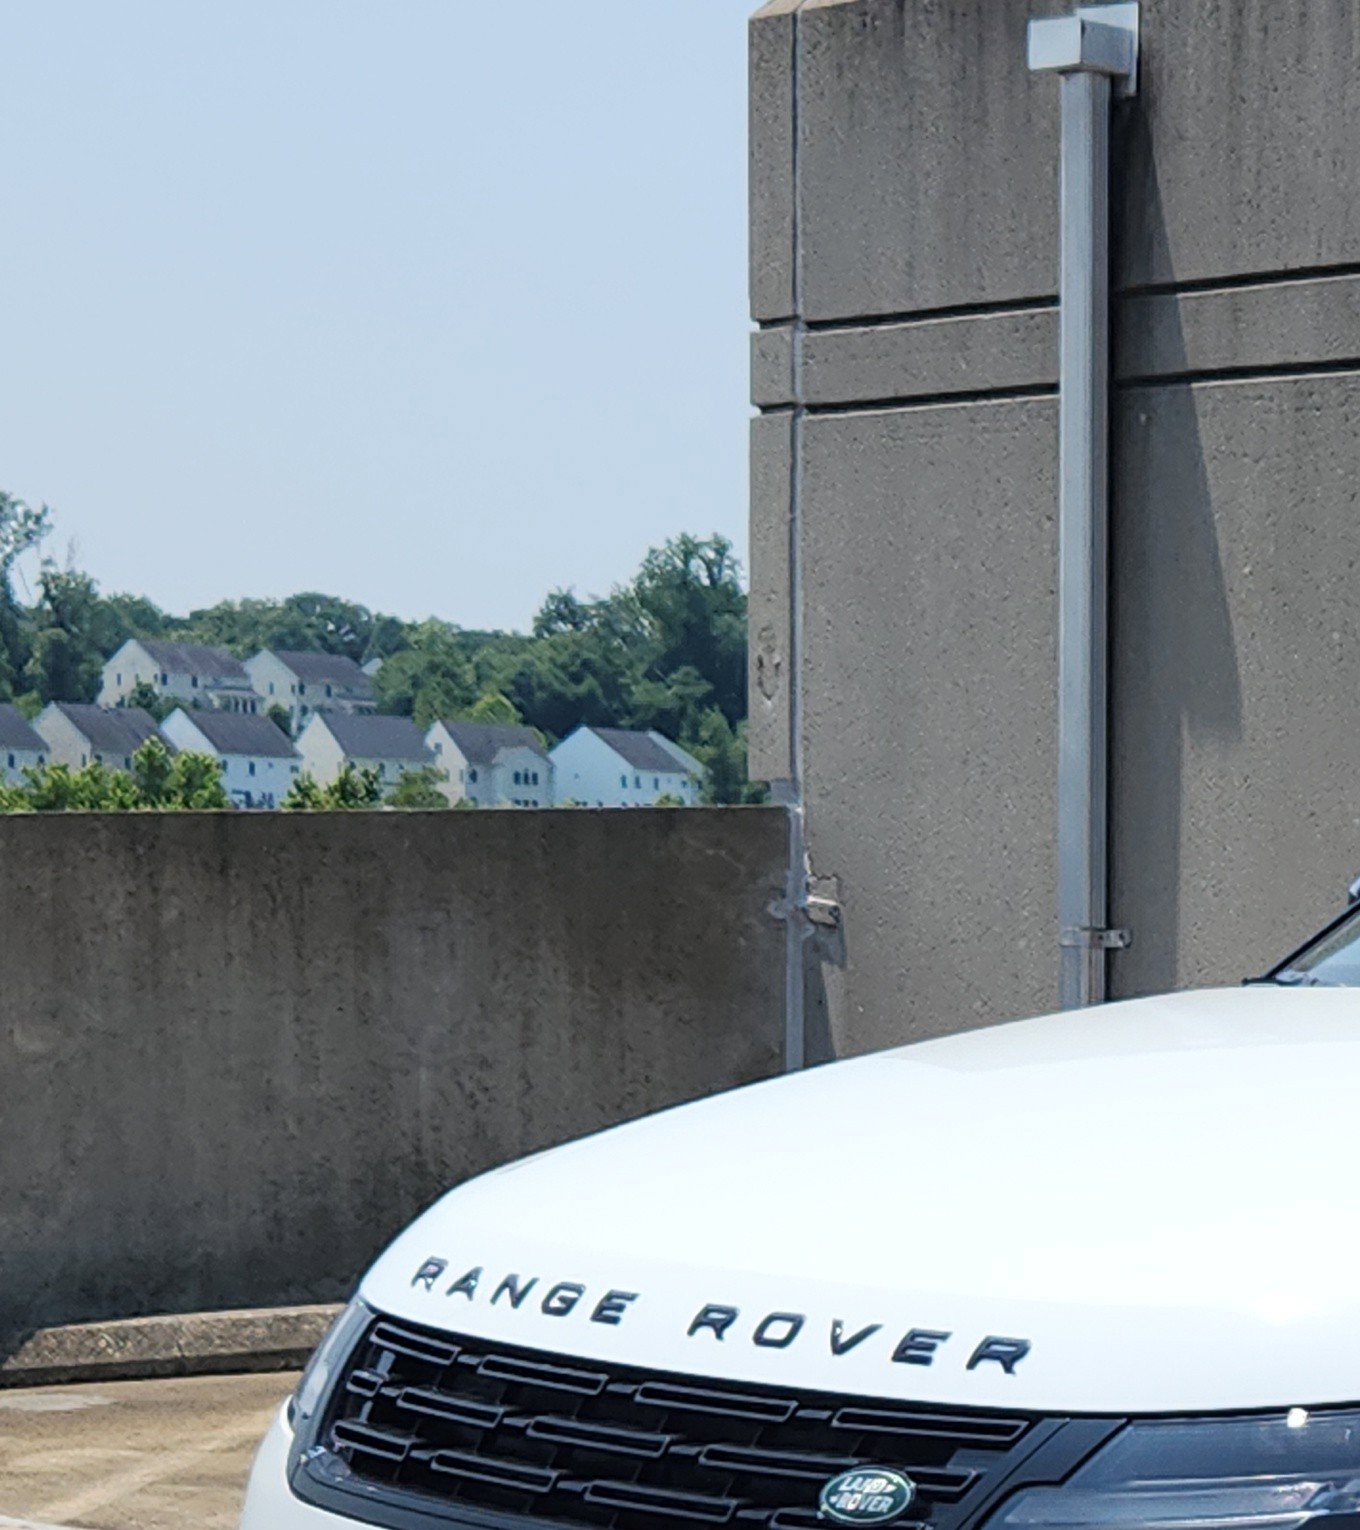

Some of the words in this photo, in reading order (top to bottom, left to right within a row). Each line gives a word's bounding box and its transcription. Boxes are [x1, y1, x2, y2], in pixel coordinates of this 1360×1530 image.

[411, 1256, 640, 1325] RANGE
[686, 1303, 1031, 1376] ROVER
[838, 1475, 889, 1494] LAND
[835, 1492, 894, 1513] ROVER
